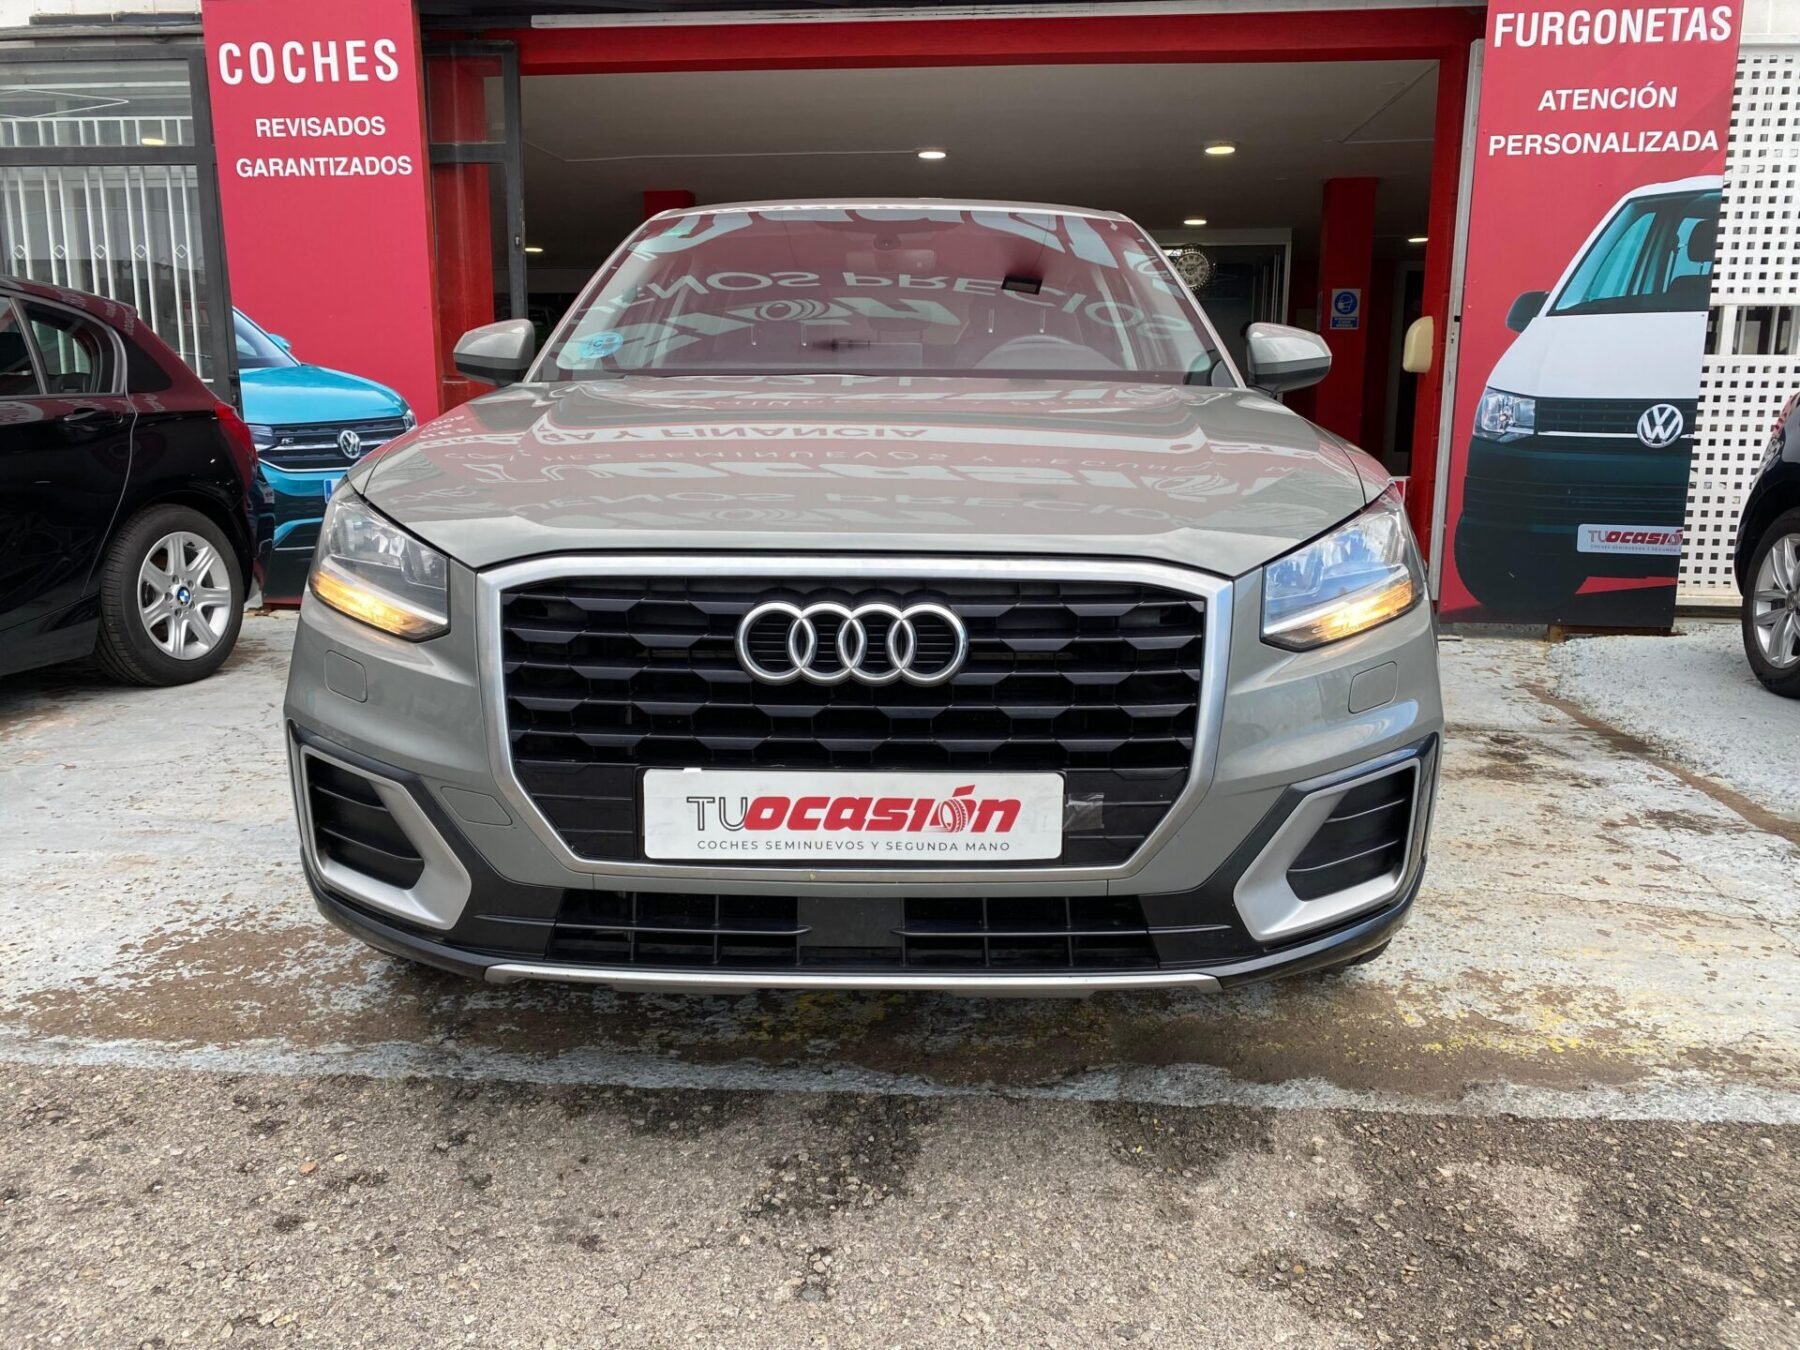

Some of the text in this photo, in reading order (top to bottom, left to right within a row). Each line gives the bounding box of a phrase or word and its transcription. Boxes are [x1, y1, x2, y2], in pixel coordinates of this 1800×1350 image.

[1493, 5, 1733, 48] FURGONETAS
[217, 38, 400, 86] COCHES
[1537, 81, 1679, 112] ATENCIÓN
[254, 115, 386, 139] REVISADOS
[1488, 129, 1720, 157] PERSONALIZADA
[234, 155, 413, 178] GARANTIZADOS
[696, 839, 1011, 852] COCHES SEMINUEVOS Y SEGUNDA MANO
